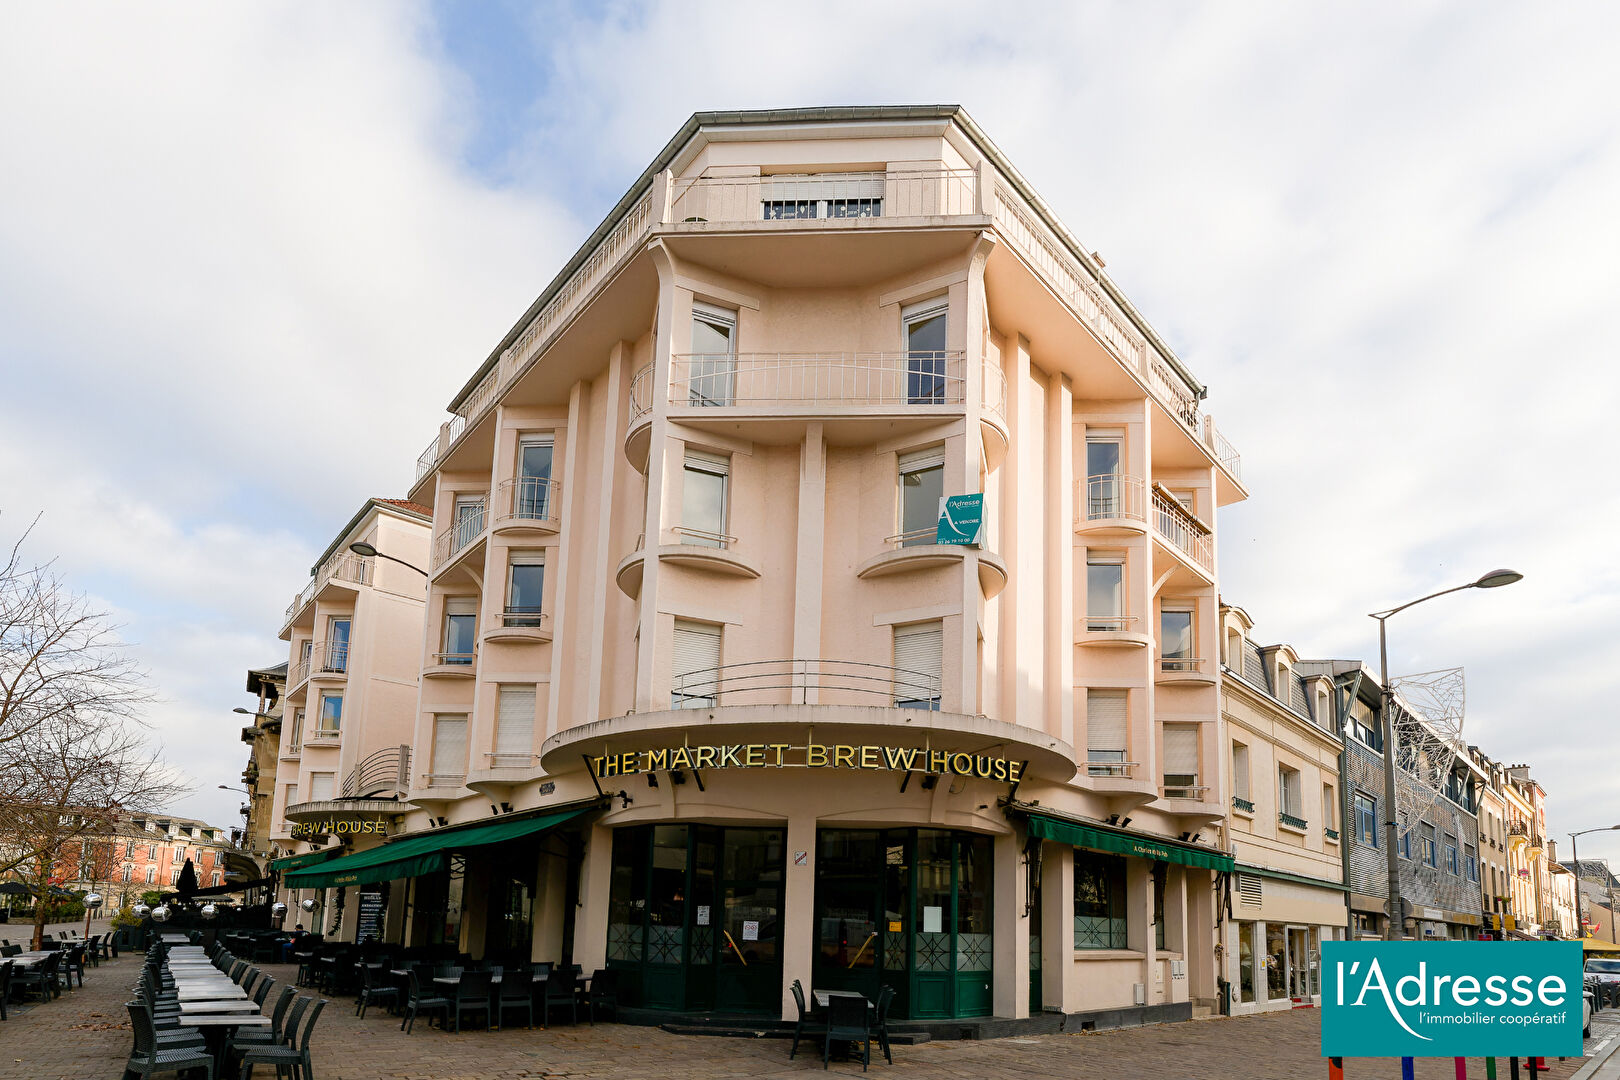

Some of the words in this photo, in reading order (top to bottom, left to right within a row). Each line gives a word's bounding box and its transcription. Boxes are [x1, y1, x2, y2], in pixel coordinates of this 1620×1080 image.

[594, 752, 638, 777] THE
[647, 743, 791, 772] MARKET
[807, 744, 919, 770] BREW
[926, 749, 1020, 783] HOUSE
[291, 822, 321, 836] BREW
[325, 820, 387, 834] HOUSE
